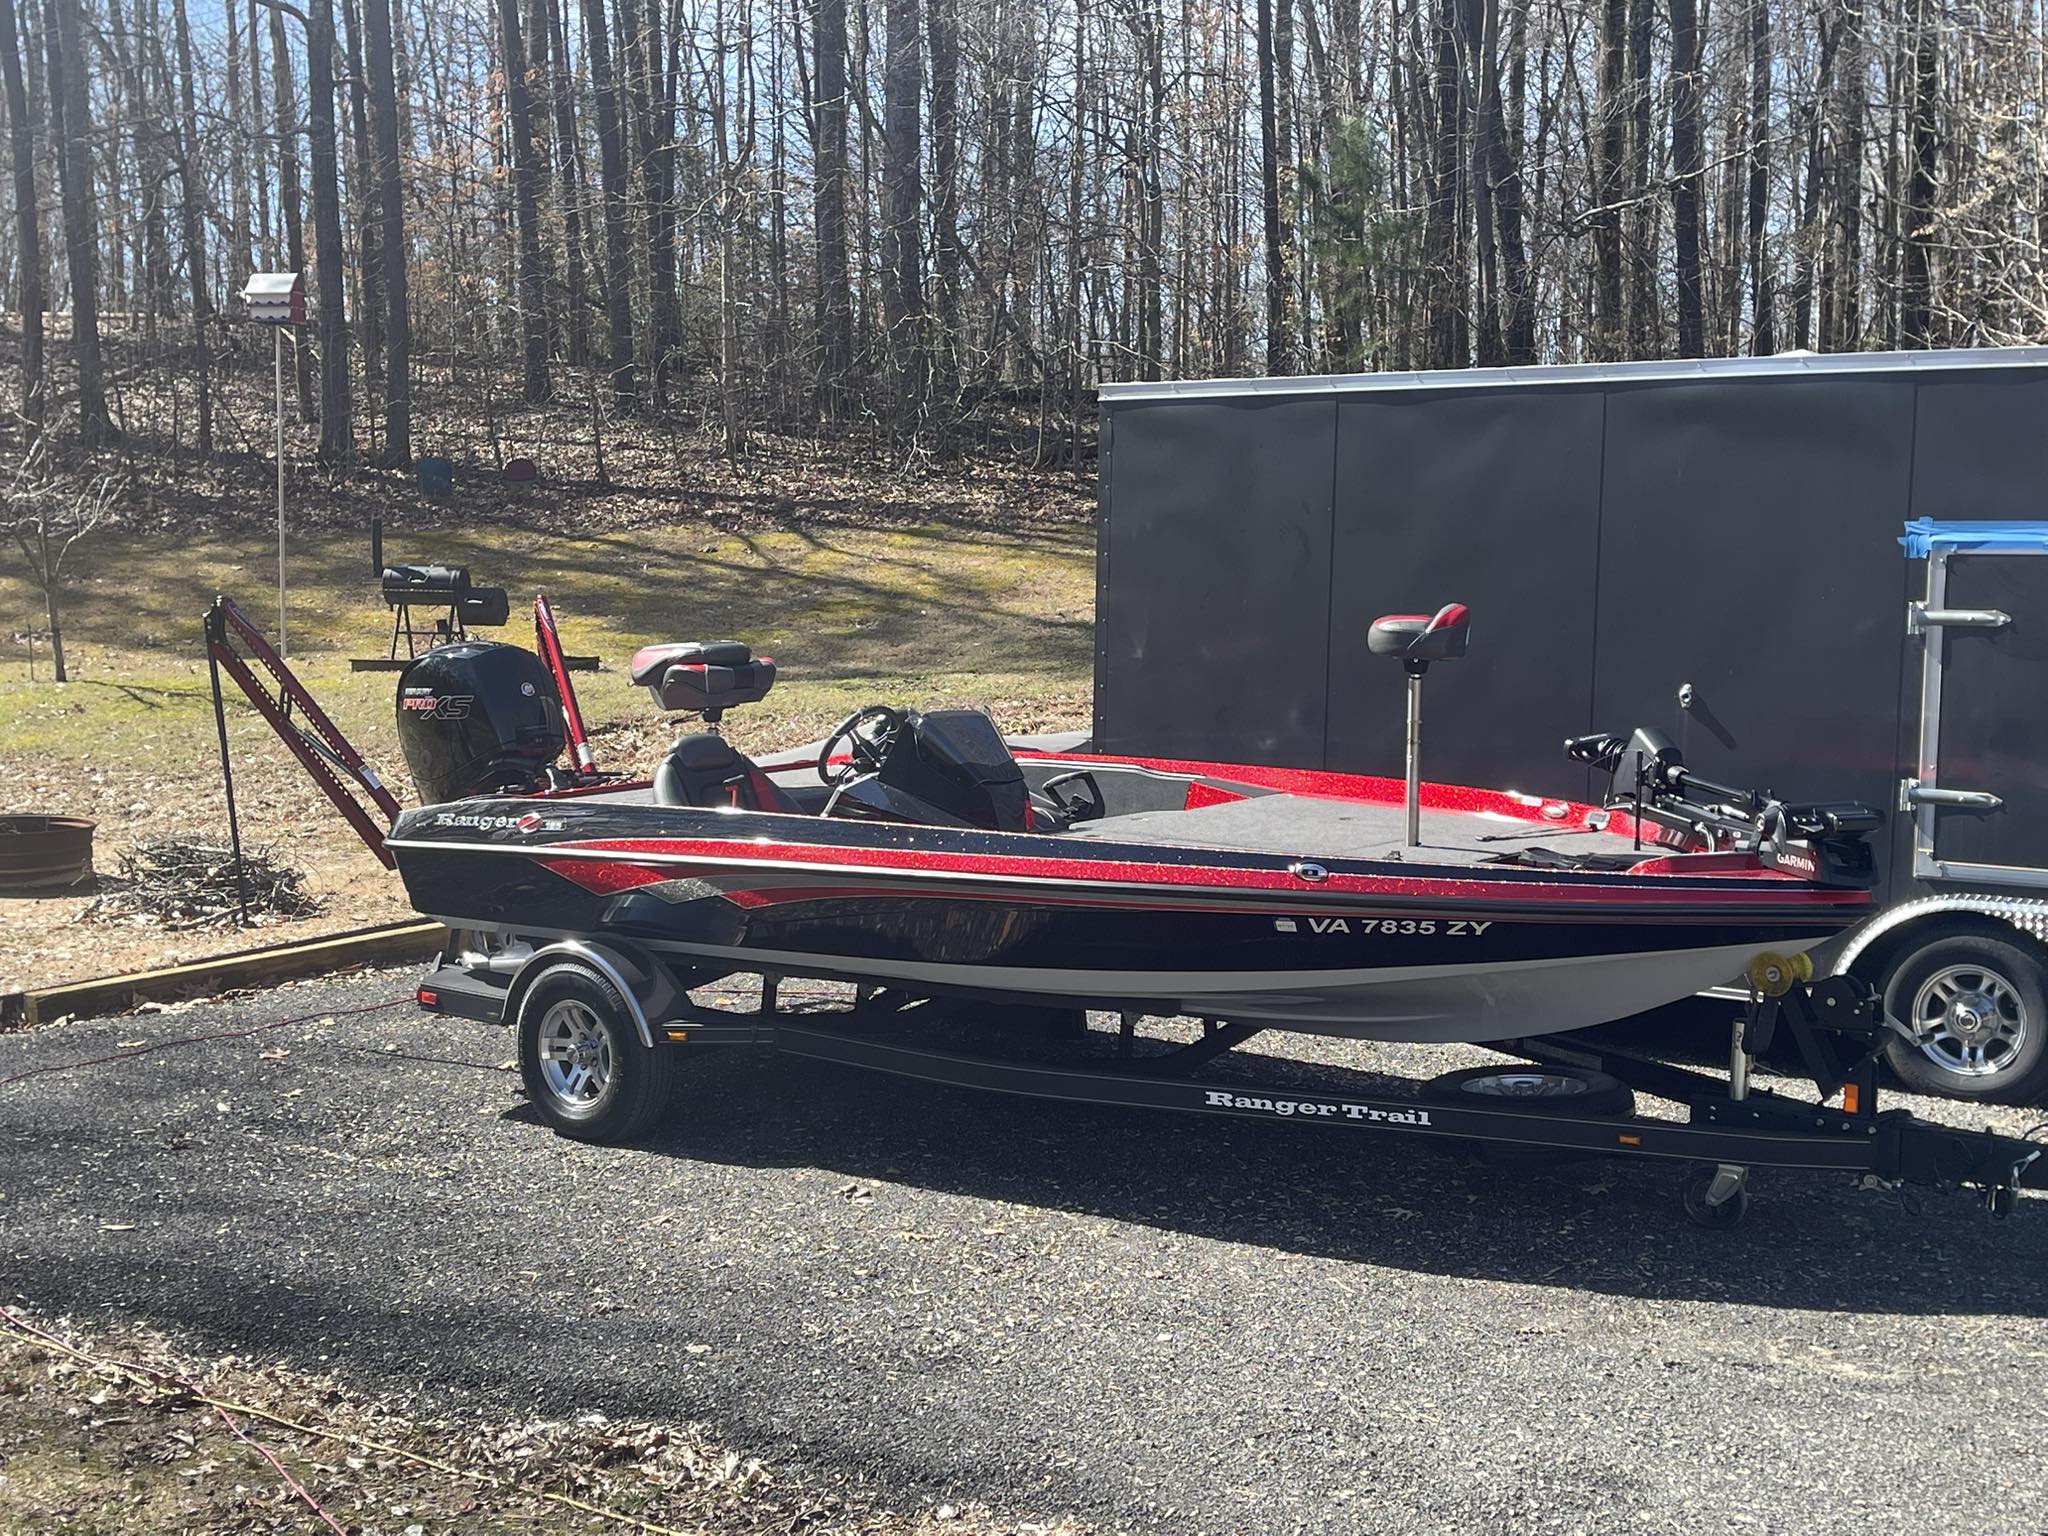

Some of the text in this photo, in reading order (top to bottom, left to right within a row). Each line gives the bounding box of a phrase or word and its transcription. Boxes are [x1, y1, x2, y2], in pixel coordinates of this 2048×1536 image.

[420, 695, 475, 720] XS
[434, 813, 520, 830] Ranger
[1777, 853, 1815, 872] GARMIN
[1308, 917, 1350, 934] VA
[1361, 919, 1436, 935] 7835
[1446, 921, 1493, 936] ZY
[1205, 1091, 1432, 1126] Ranger Trail
